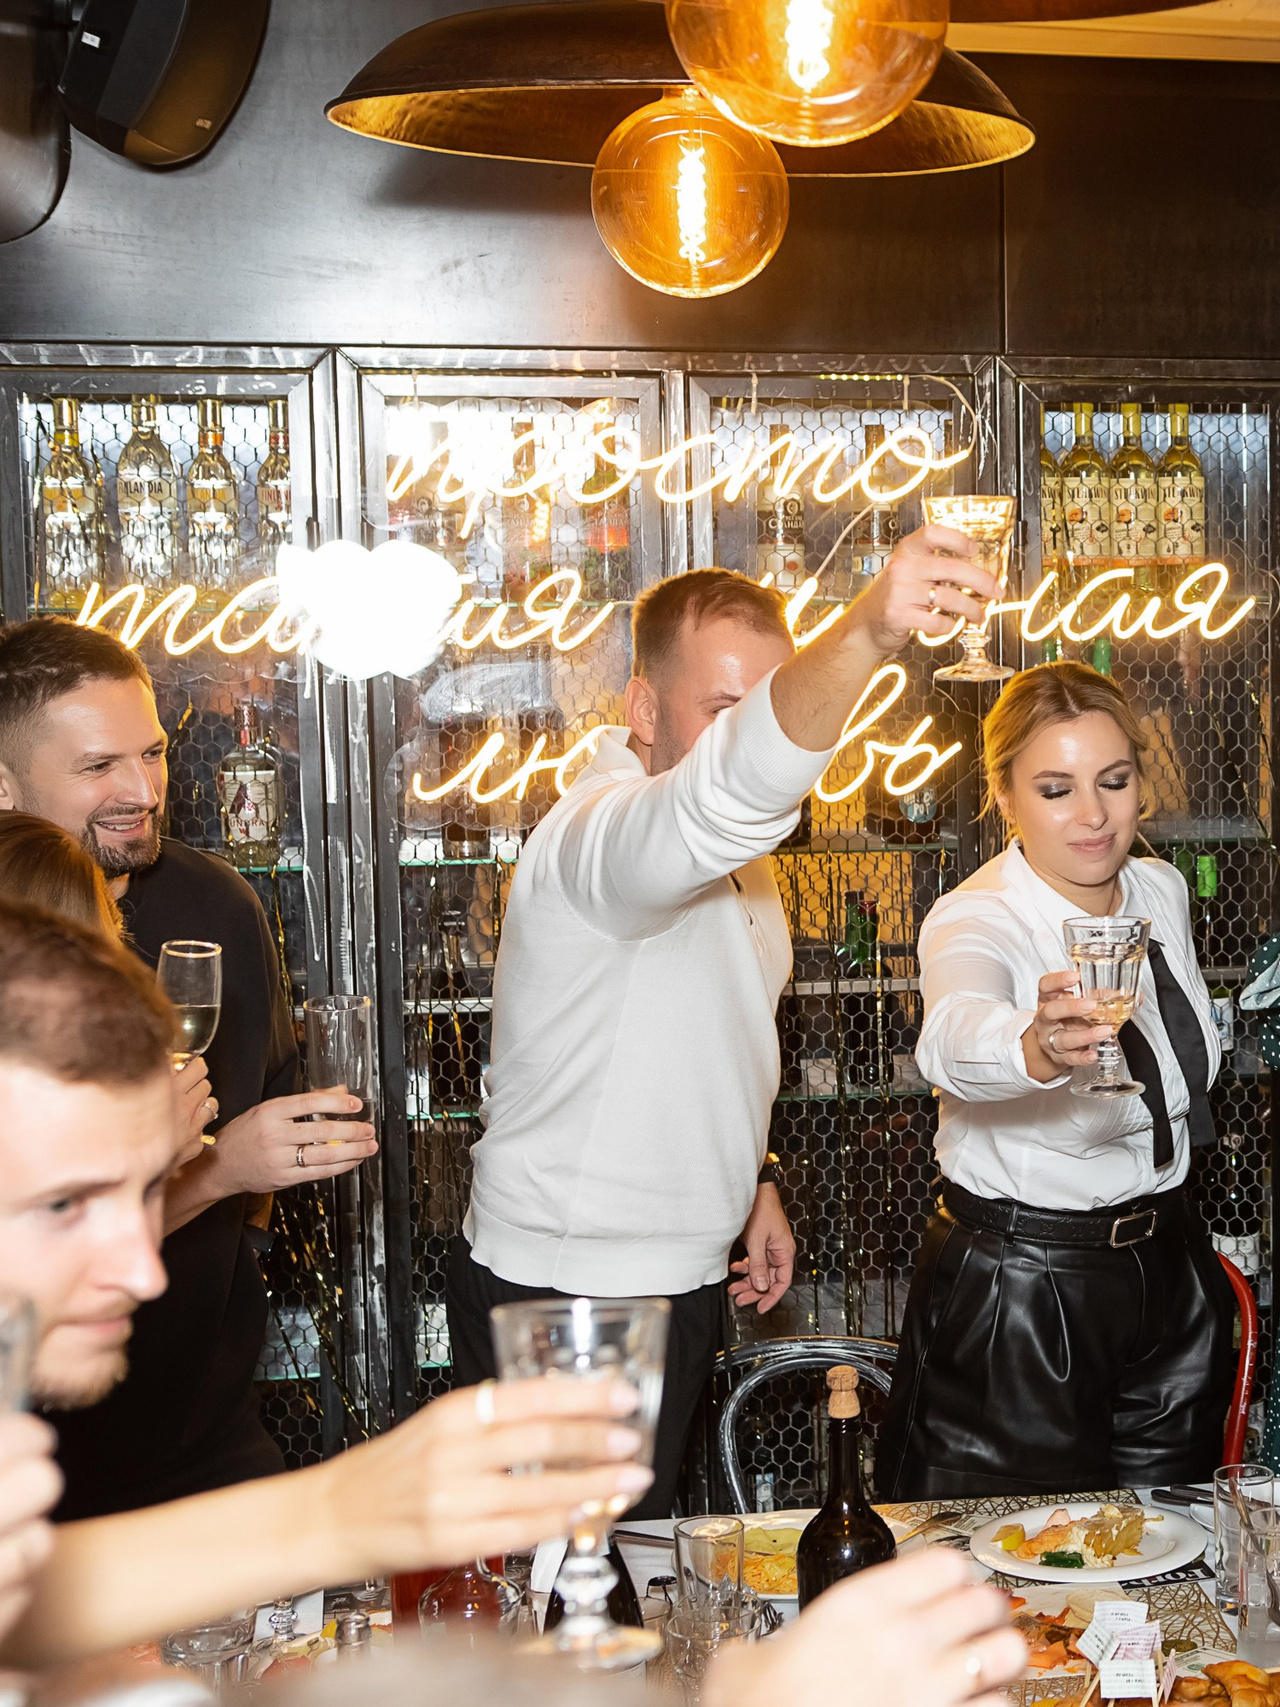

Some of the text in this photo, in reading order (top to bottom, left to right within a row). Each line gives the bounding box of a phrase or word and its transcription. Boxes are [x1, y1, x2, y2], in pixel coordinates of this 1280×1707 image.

[386, 424, 968, 538] просто
[78, 568, 614, 656] таая
[413, 662, 962, 804] лювь
